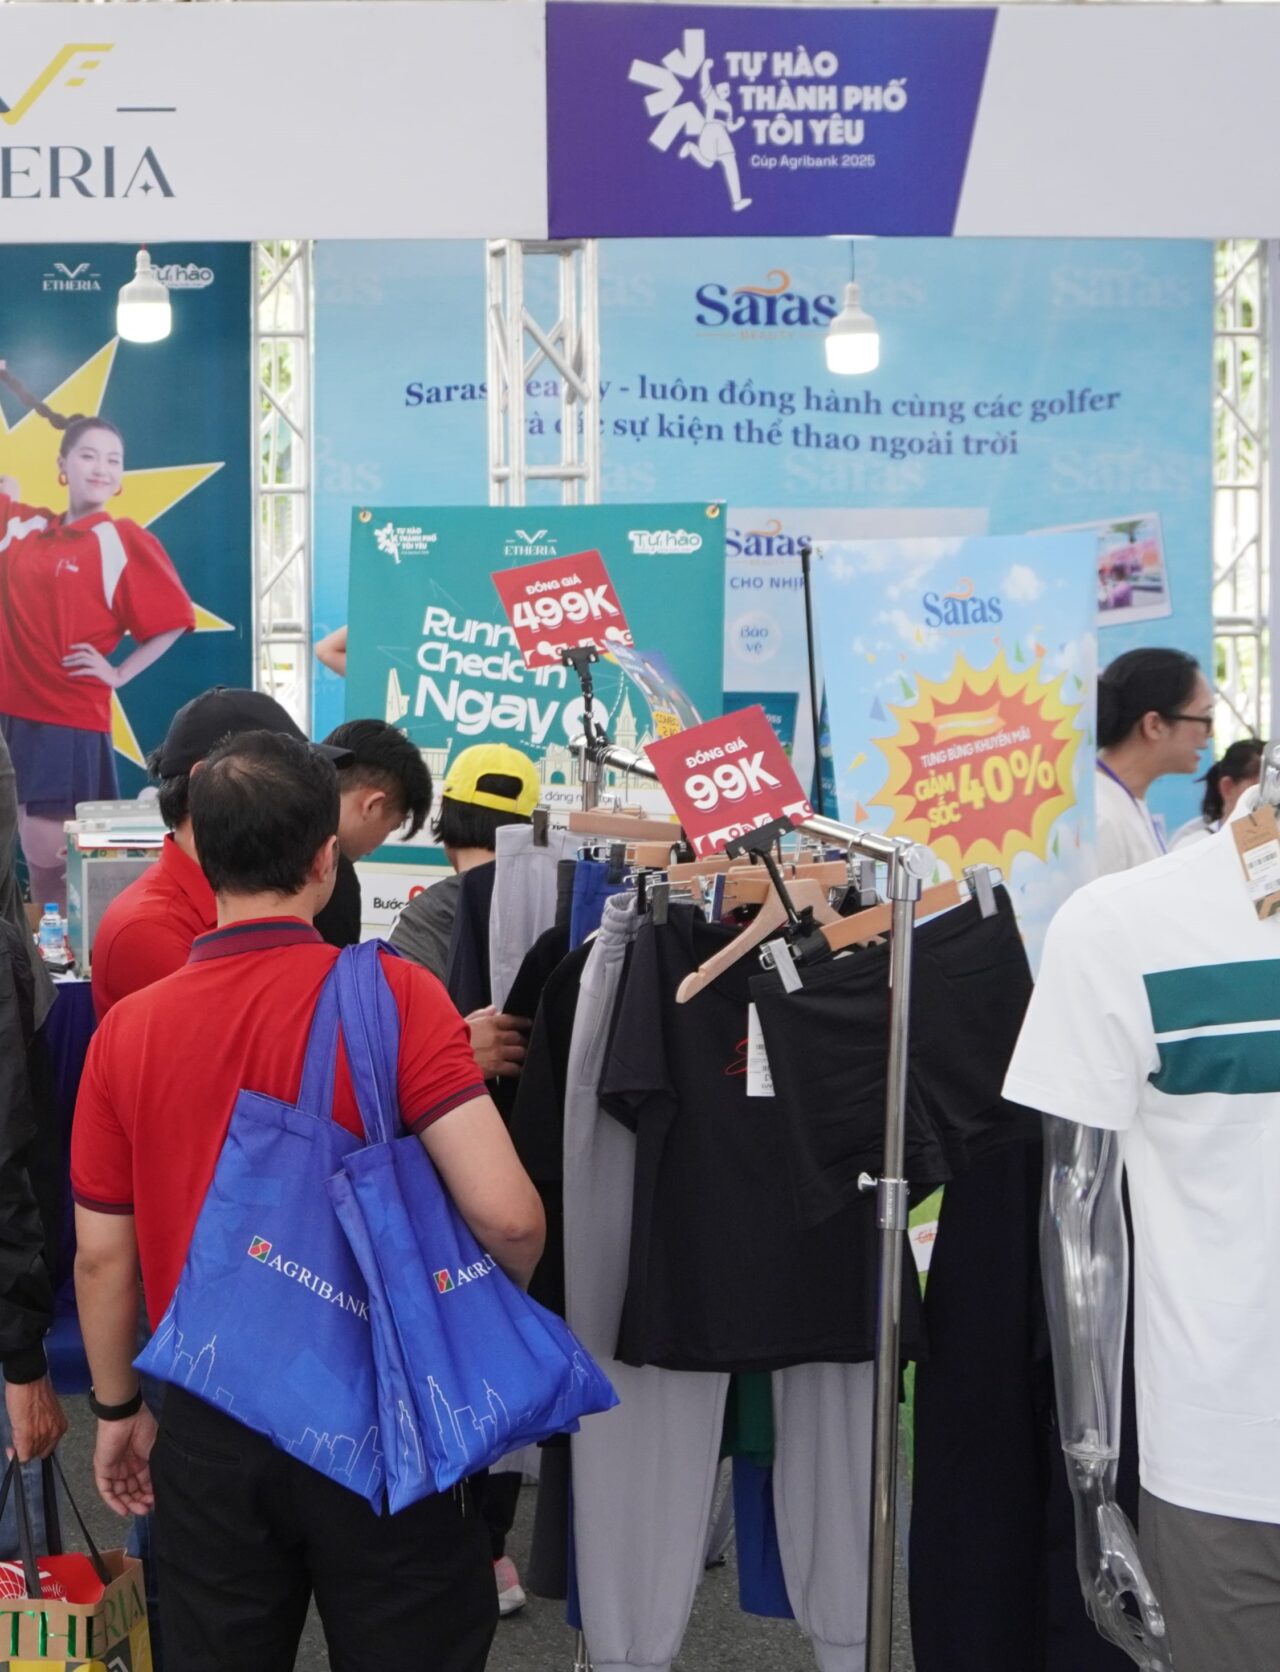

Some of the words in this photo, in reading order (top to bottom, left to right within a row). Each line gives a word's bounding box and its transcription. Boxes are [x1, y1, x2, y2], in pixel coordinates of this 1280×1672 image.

[725, 51, 768, 82] TỰ
[772, 45, 839, 78] HÀO
[739, 79, 838, 111] THÀNH
[843, 78, 908, 111] PHỐ
[752, 113, 804, 145] TÔI
[808, 113, 865, 145] YÊU
[751, 154, 778, 170] Cúp
[780, 154, 839, 170] Agribank
[841, 154, 876, 168] 2025
[42, 280, 102, 291] ETHERIA
[695, 283, 838, 327] Saras
[638, 374, 709, 404] luôn
[718, 377, 796, 416] đồng
[803, 385, 883, 416] hành
[891, 390, 966, 425] cùng
[973, 393, 1023, 419] các
[1031, 386, 1122, 423] golfer
[612, 415, 650, 443] sự
[657, 413, 725, 447] kiện
[733, 418, 784, 446] thể
[791, 423, 861, 452] thao
[869, 430, 955, 461] ngoài
[962, 429, 1019, 455] trời
[504, 545, 558, 556] ETHERIA
[725, 527, 813, 558] Saras
[561, 573, 582, 587] GIÁ
[729, 576, 764, 590] CHO
[512, 584, 621, 634] 499K
[922, 591, 1004, 628] Saras
[415, 675, 560, 745] Ngay
[724, 736, 749, 755] GIÁ
[684, 751, 782, 813] 99K
[914, 769, 957, 802] GIẢM
[958, 744, 1056, 810] 40%
[927, 795, 963, 829] SỐC
[267, 1253, 369, 1322] AGRIBANK
